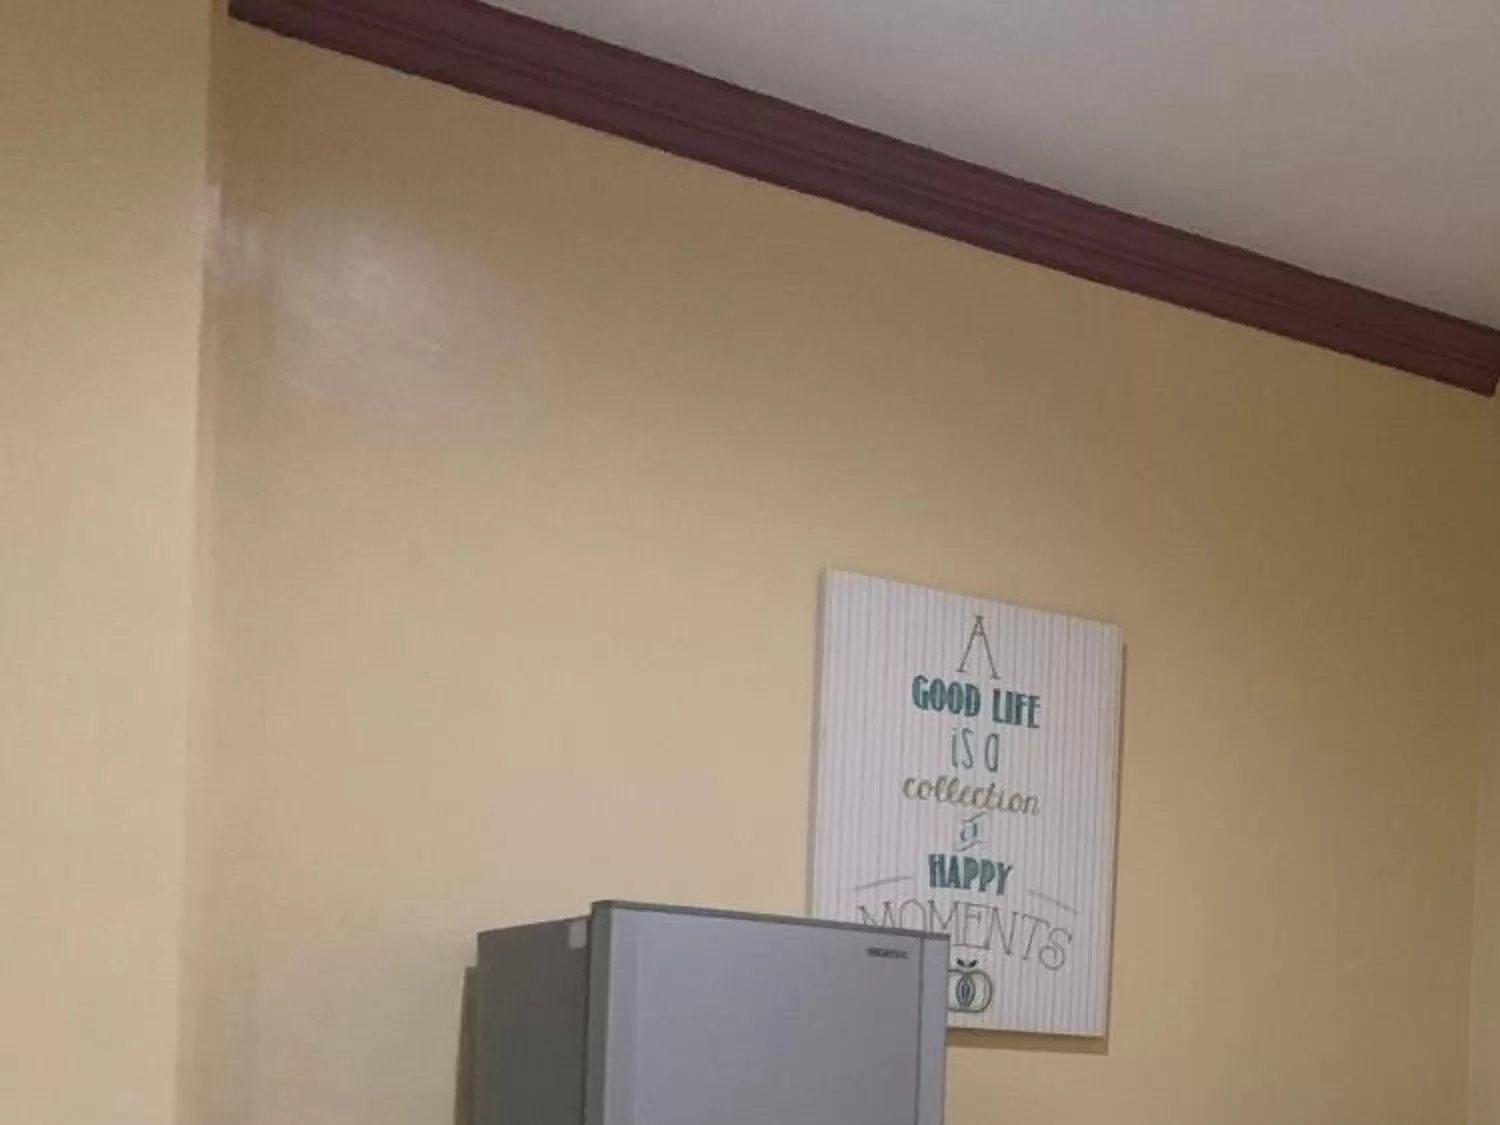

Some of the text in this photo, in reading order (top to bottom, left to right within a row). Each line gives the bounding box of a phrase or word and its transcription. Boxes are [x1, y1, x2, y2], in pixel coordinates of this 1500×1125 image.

[955, 615, 1001, 680] A
[911, 674, 1041, 729] GOOD LIFE
[902, 774, 1041, 816] collection
[928, 853, 1013, 896] HAPPY
